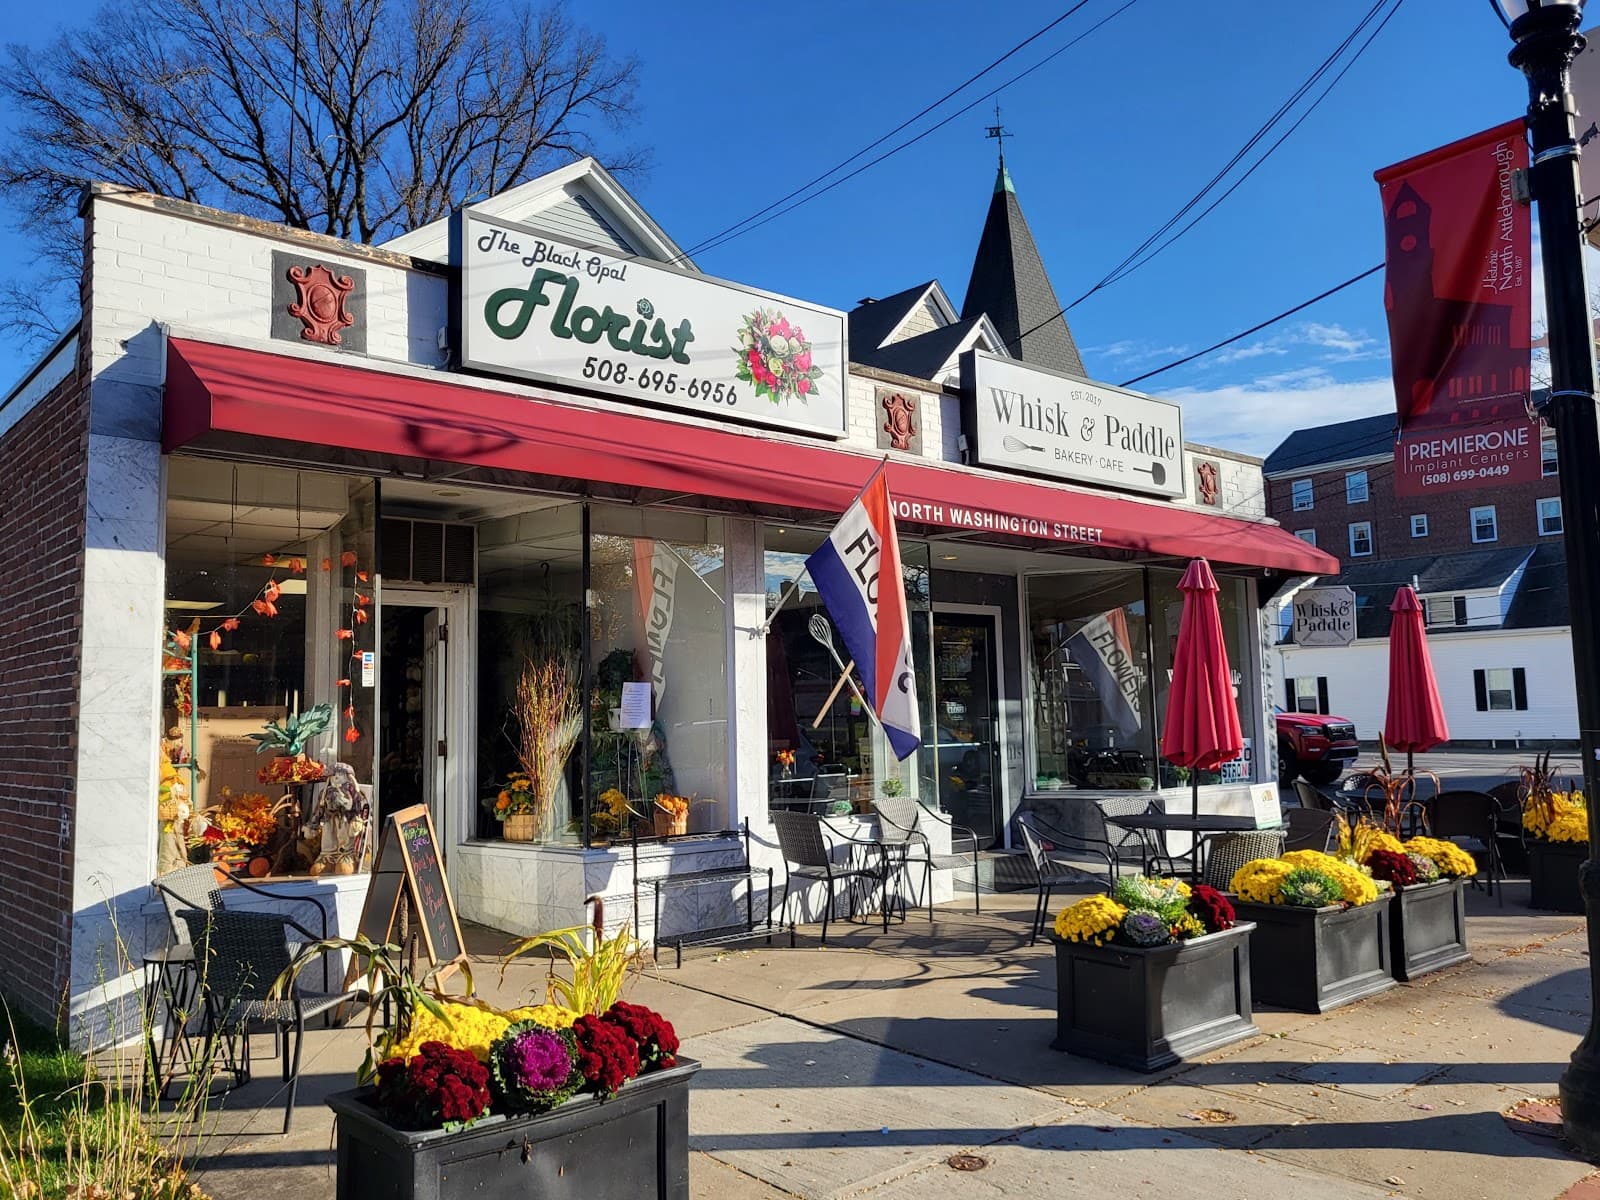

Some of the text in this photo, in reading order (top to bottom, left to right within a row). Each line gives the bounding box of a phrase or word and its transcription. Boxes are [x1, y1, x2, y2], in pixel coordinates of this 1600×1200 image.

[1491, 141, 1514, 291] North Attleborough
[477, 228, 627, 284] The Black Opal
[1482, 249, 1499, 295] Historic
[484, 266, 695, 365] Florist
[582, 356, 737, 406] 508-695-6956
[1085, 393, 1102, 408] 2017
[990, 386, 1176, 461] Whisk & Paddle
[1409, 427, 1529, 461] PREMIERONE
[1054, 447, 1124, 473] BAKERY CAFE
[1410, 449, 1529, 473] Implant Centers
[1422, 464, 1510, 486] (508) 699-0449
[891, 500, 1103, 543] NORTH WASHINGTON STREET
[1296, 602, 1339, 617] Whisk
[1296, 618, 1351, 632] Paddle
[1092, 630, 1141, 713] FLOWERS
